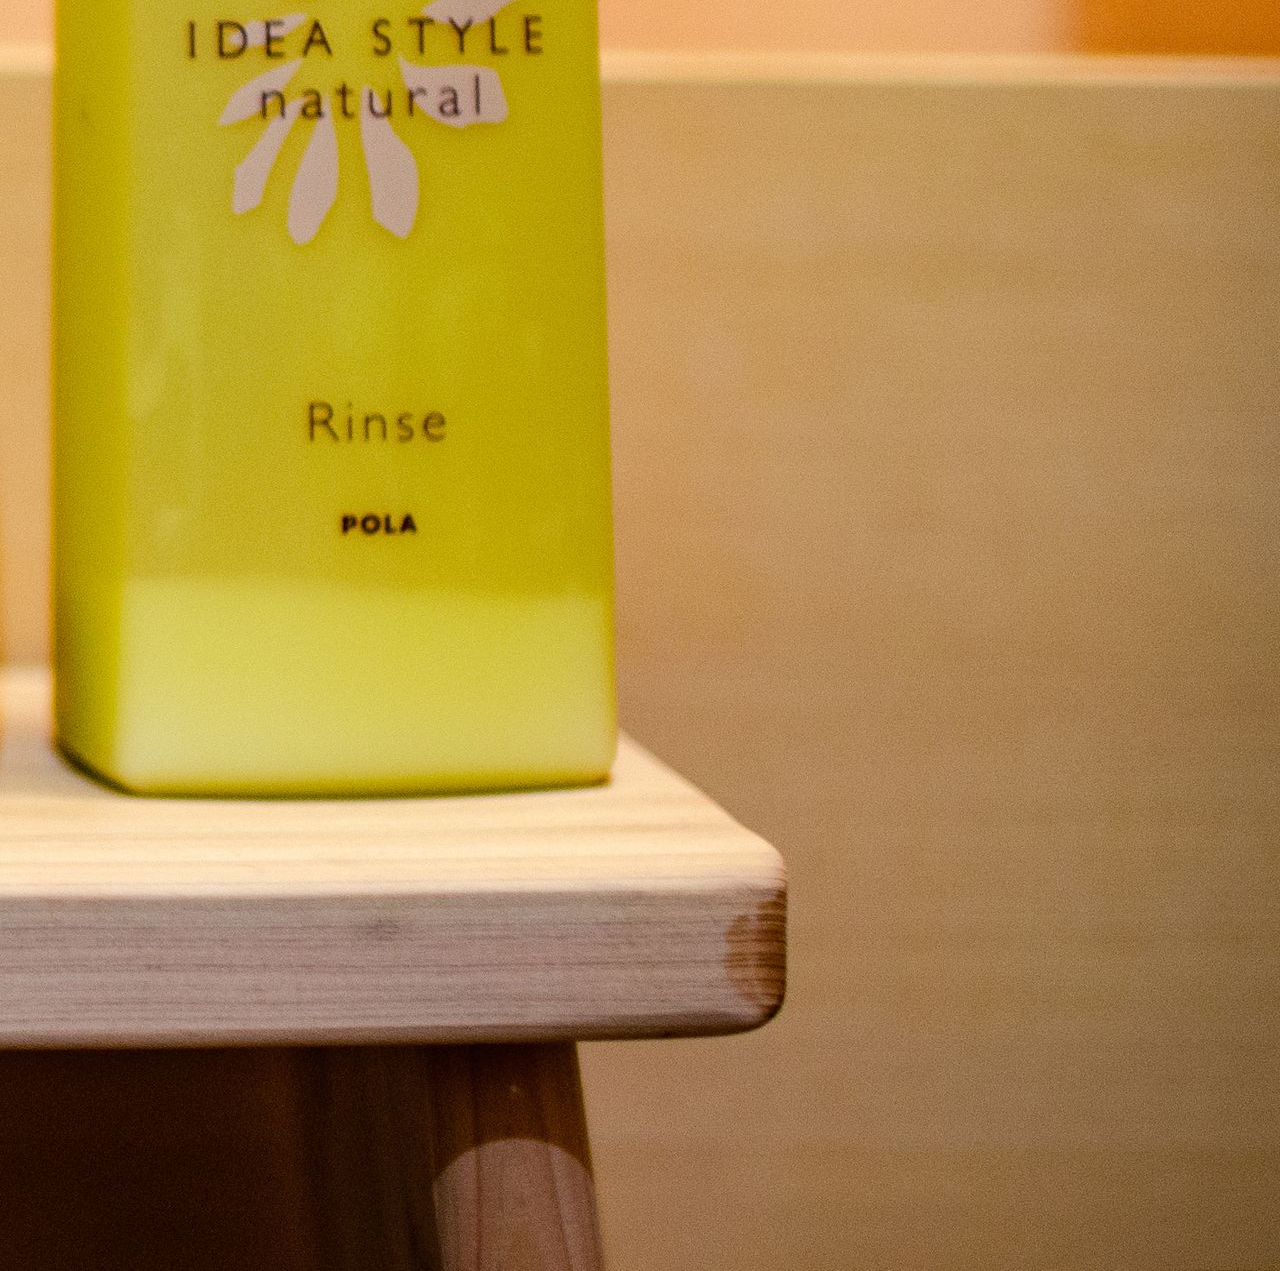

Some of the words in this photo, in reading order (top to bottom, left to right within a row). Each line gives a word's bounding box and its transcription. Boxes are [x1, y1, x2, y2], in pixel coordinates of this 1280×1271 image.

[188, 19, 333, 59] IDEA
[372, 15, 544, 56] STYLE
[260, 75, 482, 119] natural
[307, 401, 447, 442] Rinse
[341, 513, 417, 534] POLA
